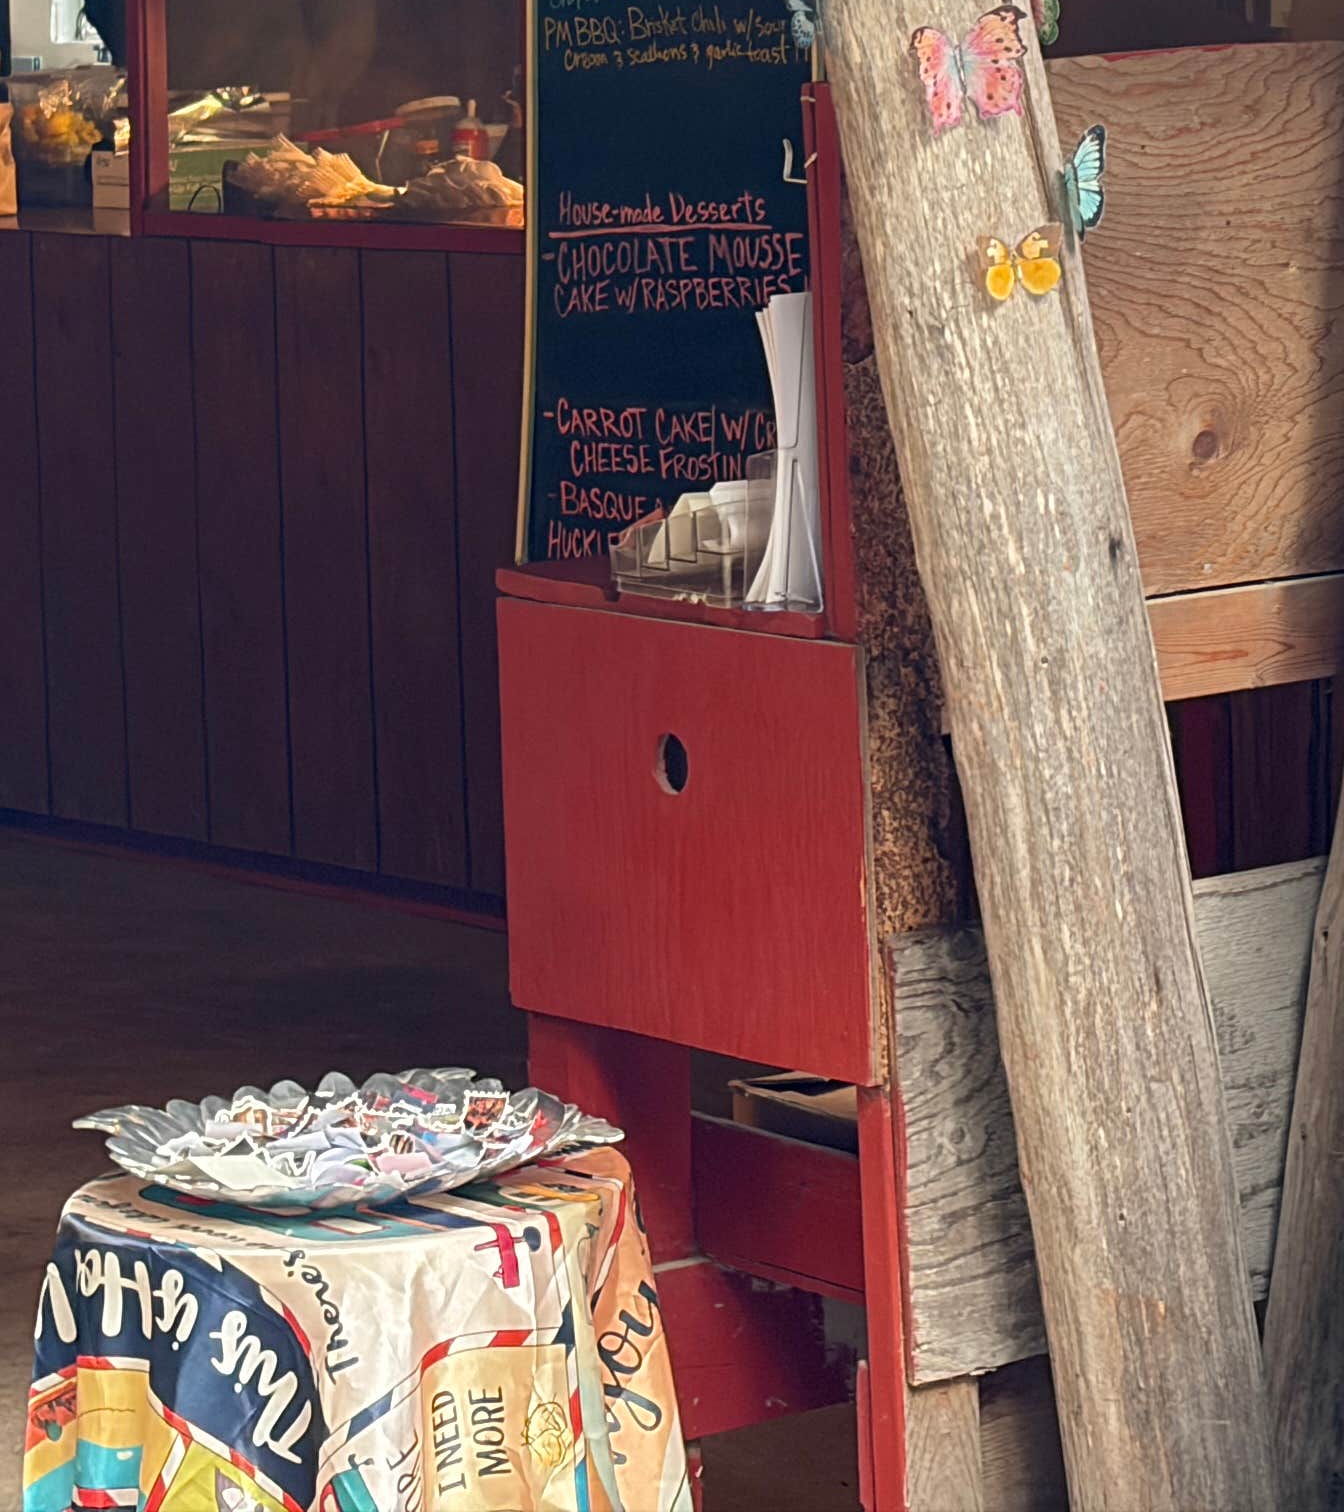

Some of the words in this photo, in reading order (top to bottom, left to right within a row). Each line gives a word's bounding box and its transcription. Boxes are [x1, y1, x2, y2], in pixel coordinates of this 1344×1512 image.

[668, 190, 769, 225] Desserts
[709, 232, 805, 276] MOUSSE
[554, 279, 609, 319] CAKE
[569, 439, 656, 479] CHEESE
[659, 445, 744, 482] FROSTIN
[152, 1267, 200, 1352] is
[207, 1309, 314, 1466] This
[430, 1389, 463, 1466] NEED
[467, 1383, 513, 1480] MORE
